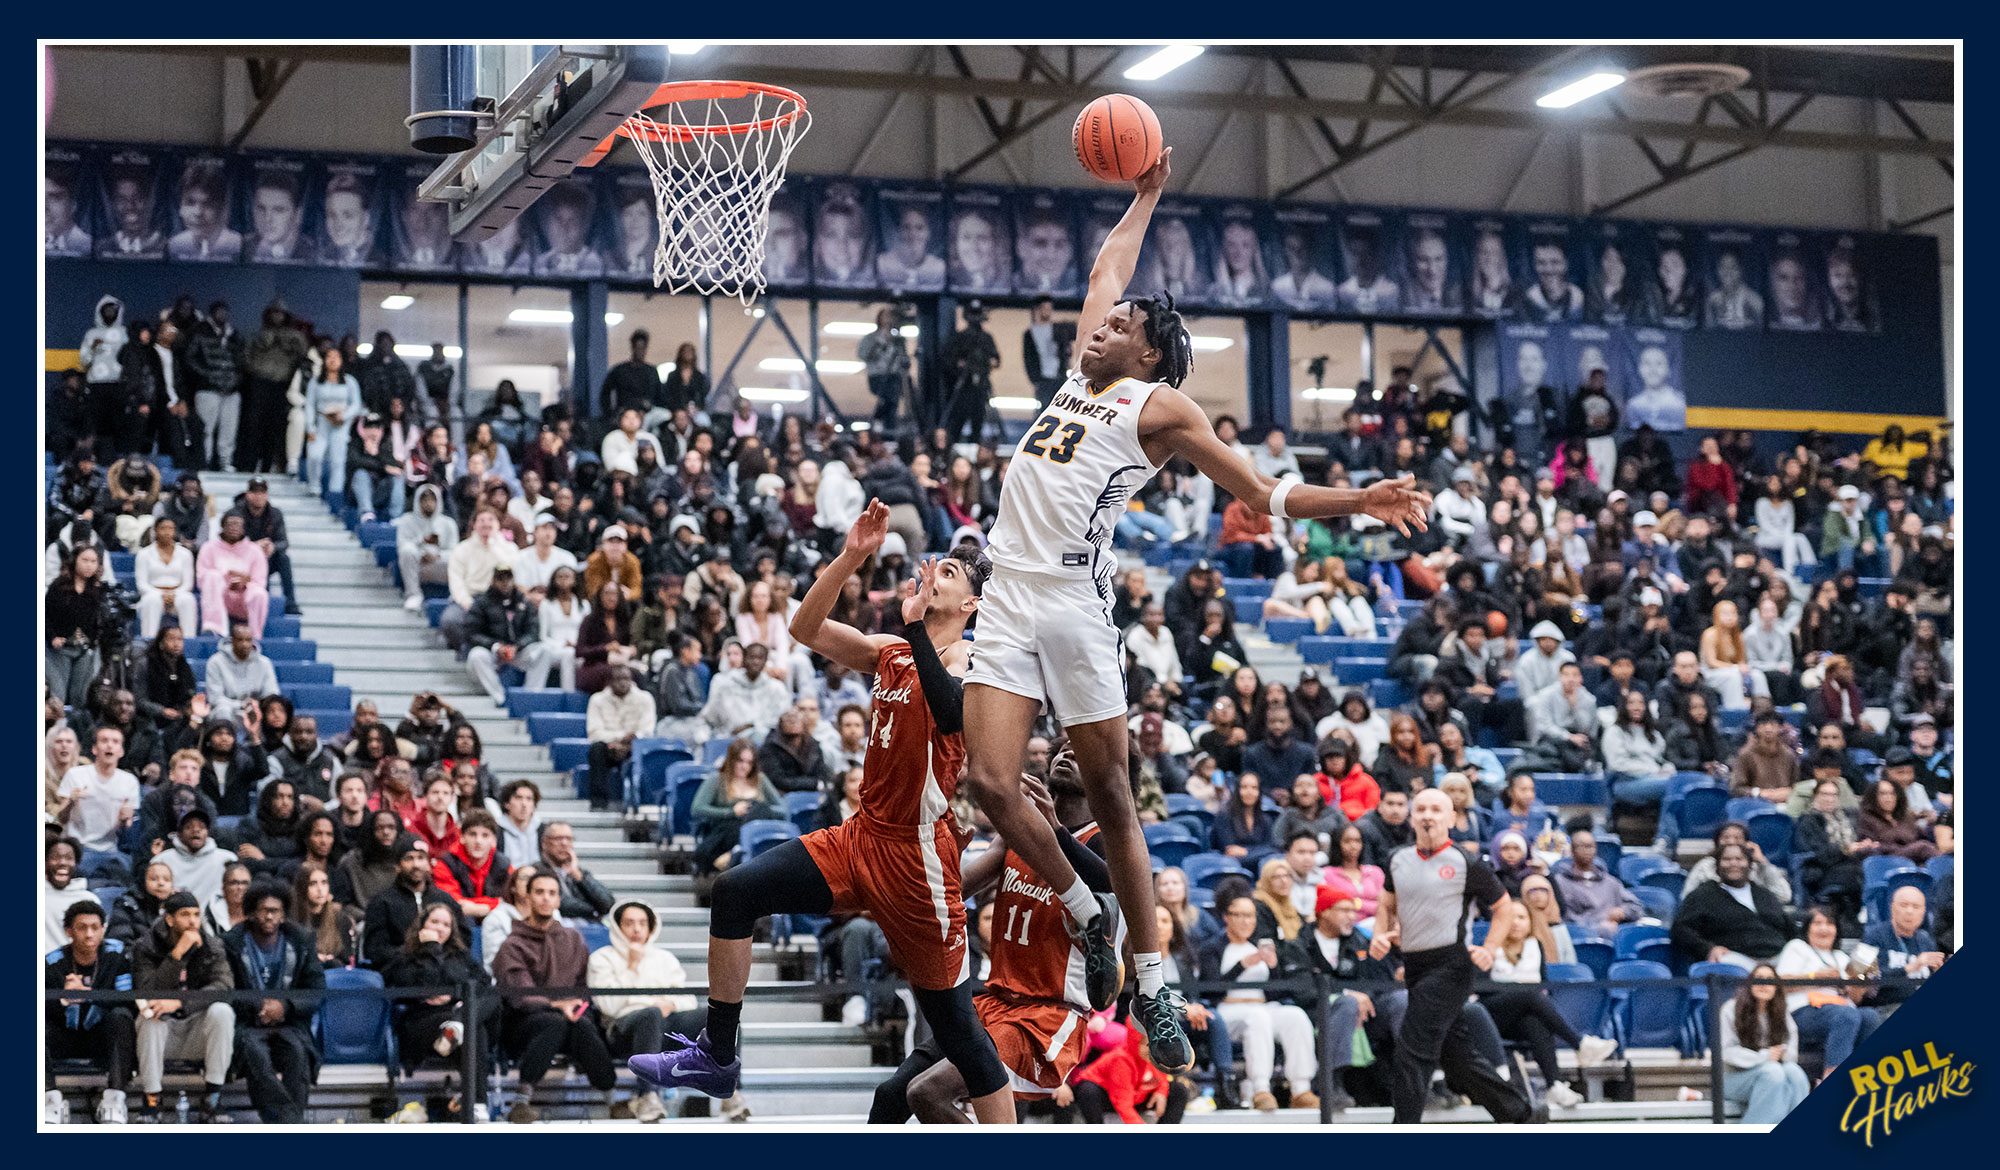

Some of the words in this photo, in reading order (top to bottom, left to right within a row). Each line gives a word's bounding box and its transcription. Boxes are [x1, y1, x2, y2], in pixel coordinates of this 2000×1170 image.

[1022, 414, 1088, 465] 23
[869, 709, 894, 749] 14
[1003, 904, 1033, 946] 11
